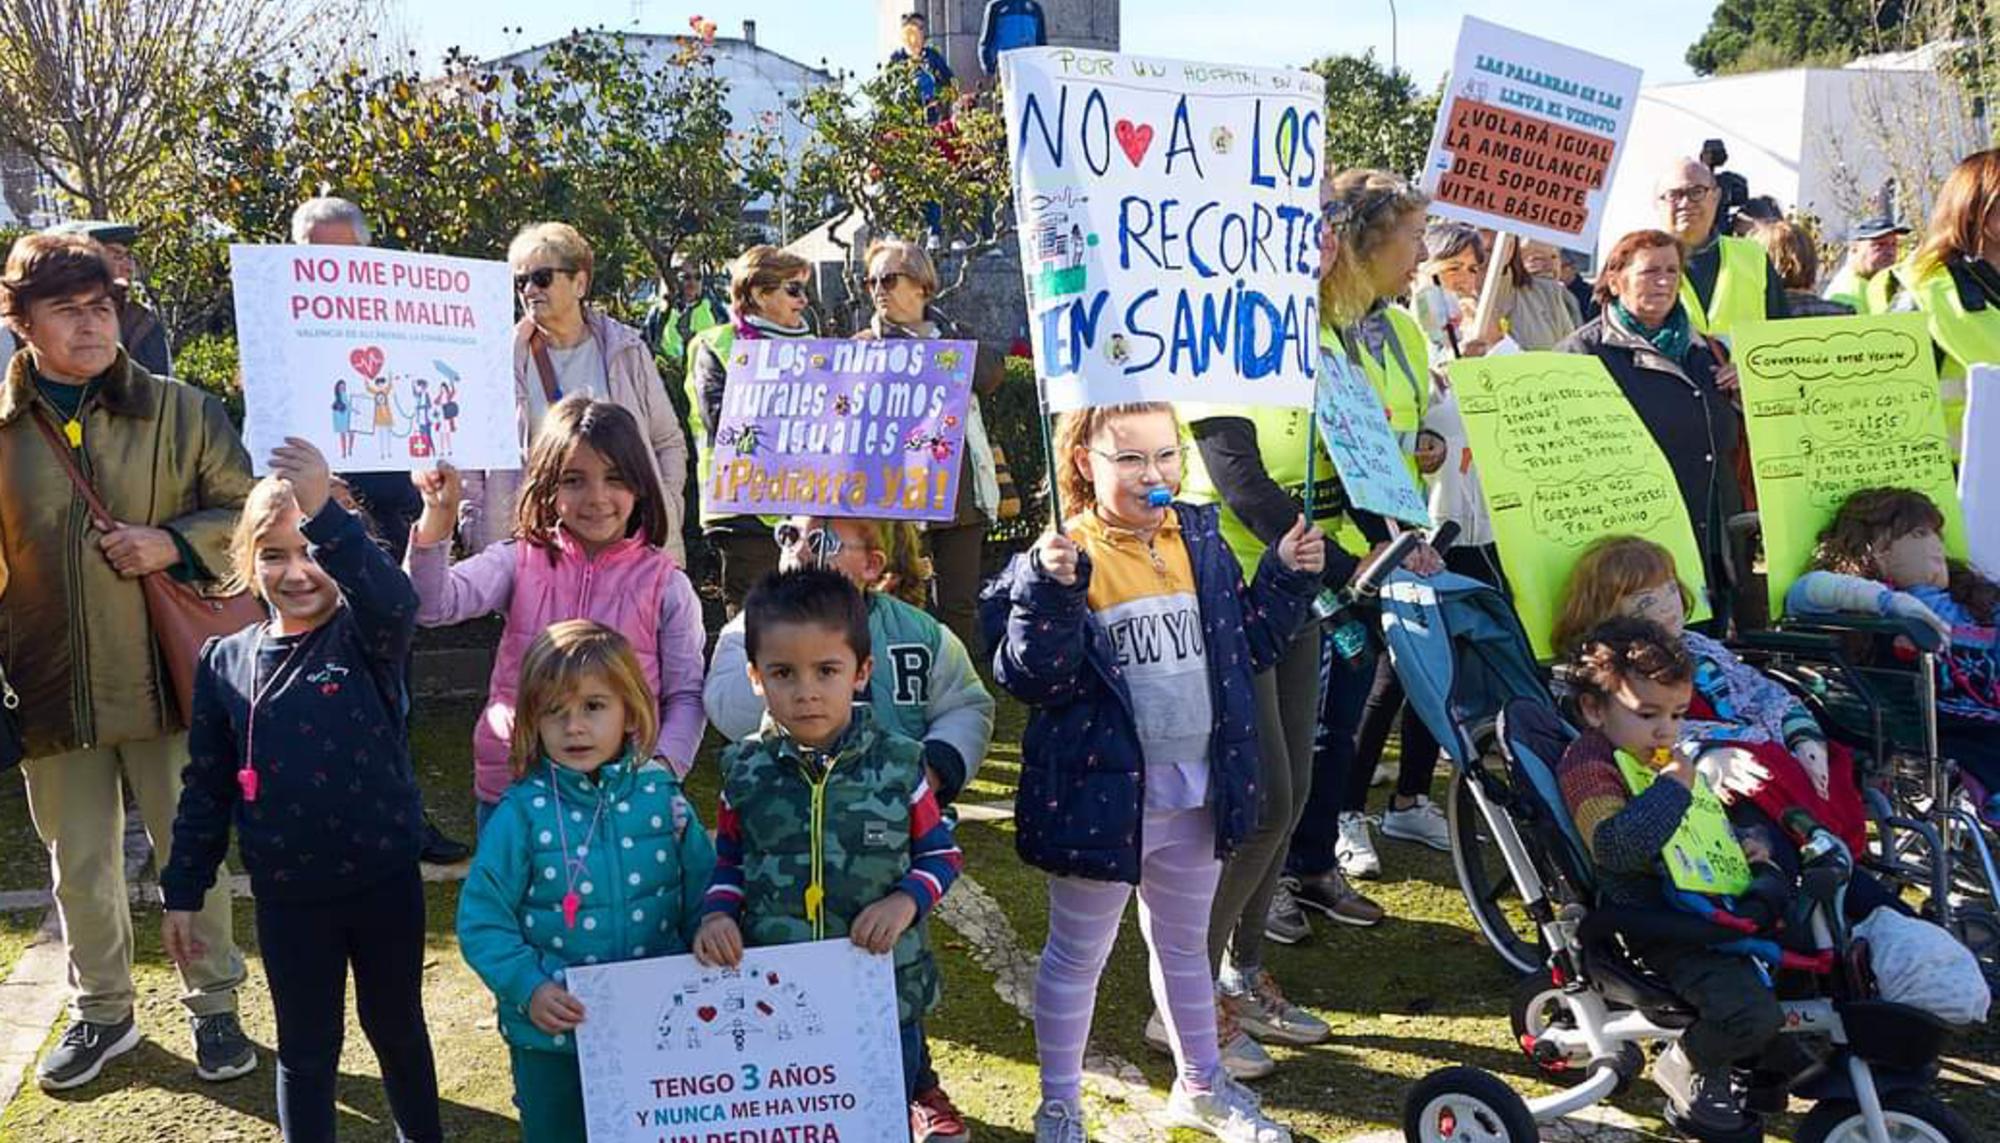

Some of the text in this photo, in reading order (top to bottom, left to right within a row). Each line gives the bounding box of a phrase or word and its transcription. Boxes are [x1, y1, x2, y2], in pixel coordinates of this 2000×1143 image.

[1050, 50, 1114, 76] POR
[1184, 65, 1260, 87] HOSPITAL
[1474, 55, 1623, 110] LAS PALABRAS SE LAS
[1499, 87, 1616, 134] LLEVA EL VIENTO
[1019, 85, 1321, 189] NO A LOS
[1446, 130, 1602, 187] LA AMBULANCIA
[1458, 109, 1609, 164] ¿VOLARÁ IGUAL
[1441, 180, 1583, 231] VITAL BÁSICO?
[1453, 158, 1586, 207] DEL SOPORTE
[293, 258, 470, 293] NO ME PUEDO
[291, 295, 476, 328] PONER MALITA
[1041, 289, 1109, 378] EN
[755, 340, 925, 380] Los niños
[731, 381, 946, 418] rurales somos
[1602, 510, 1648, 528] CAMINO
[1109, 610, 1203, 666] EW YO
[887, 643, 932, 705] R
[651, 1063, 836, 1099] TENGO 3 AÑOS
[637, 1093, 856, 1127] Y NUNCA ME HA VISTO
